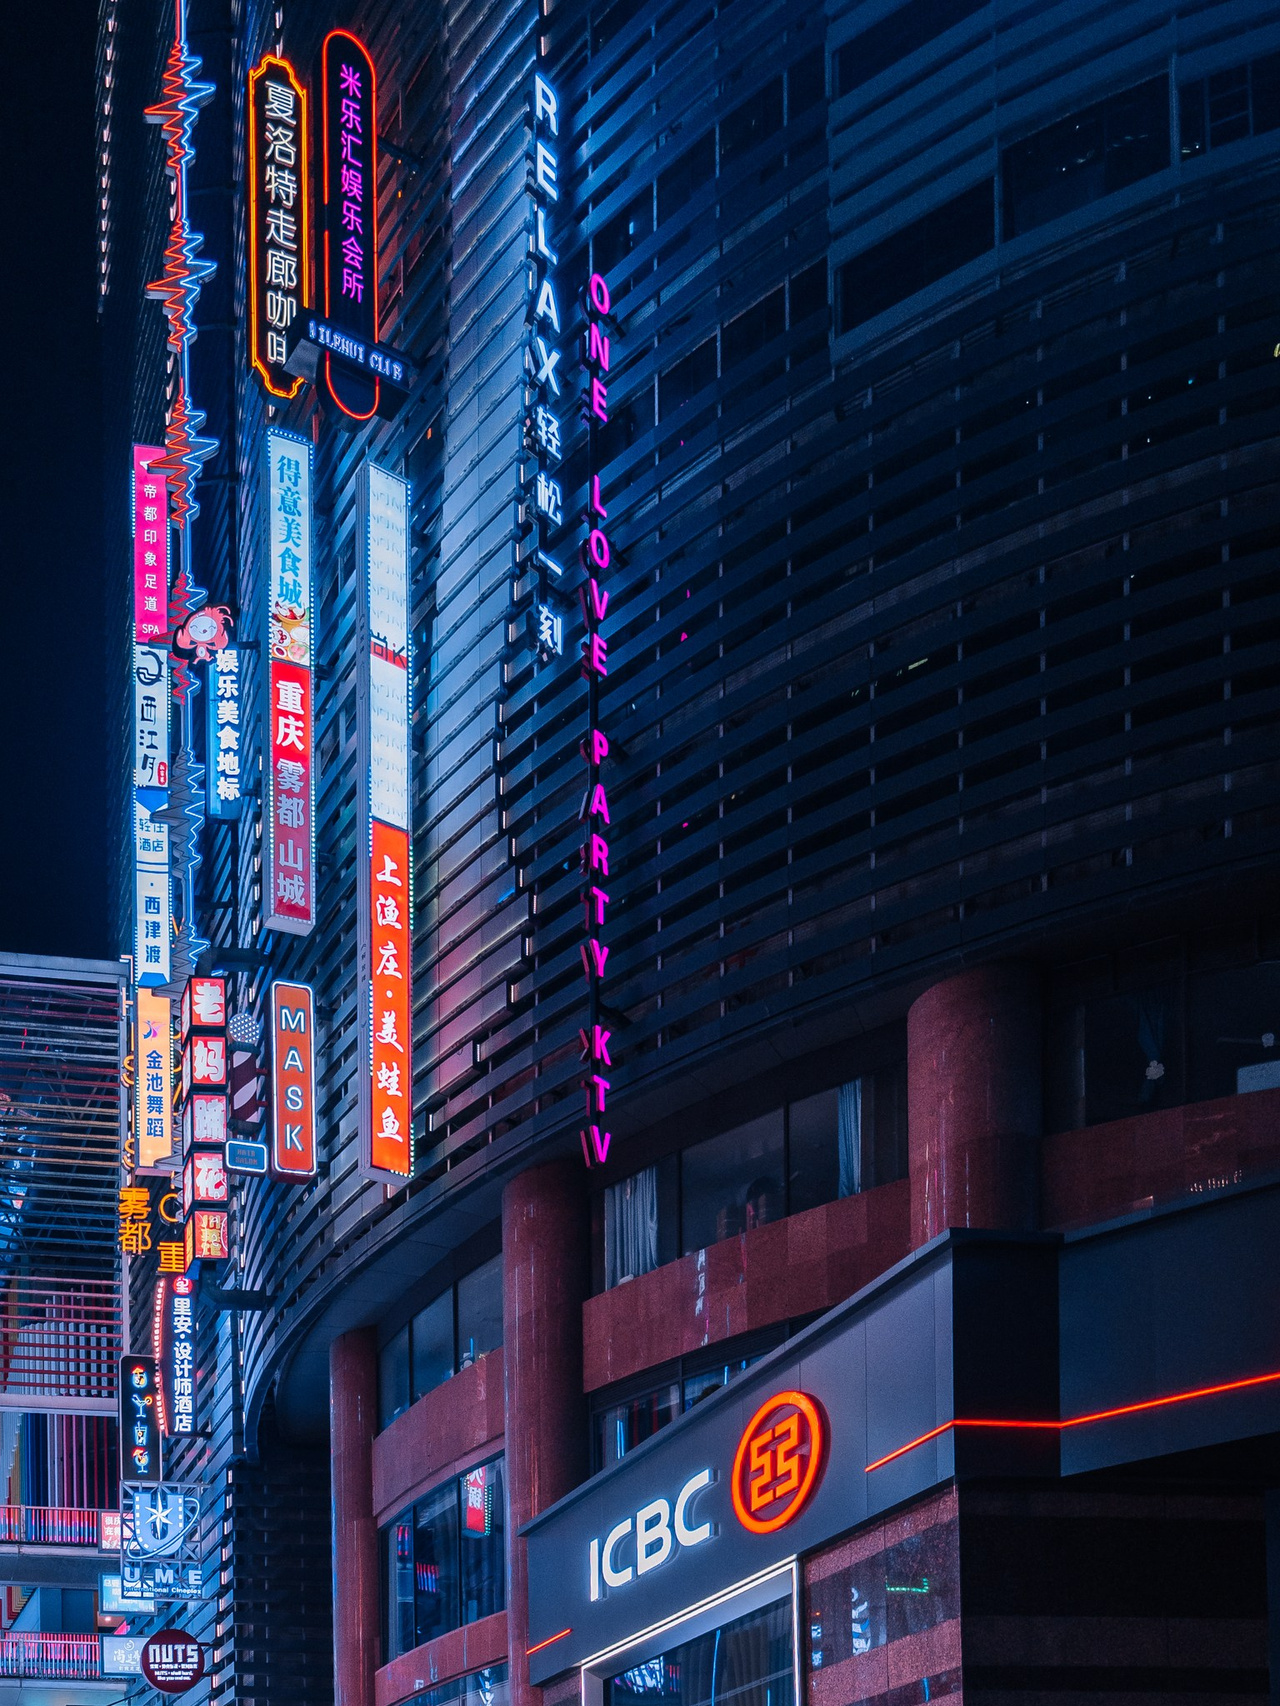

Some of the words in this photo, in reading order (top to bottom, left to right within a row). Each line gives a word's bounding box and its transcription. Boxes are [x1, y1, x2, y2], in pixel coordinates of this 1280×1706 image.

[340, 63, 365, 304] 米乐汇娱乐会所
[143, 483, 158, 612] 帝都印象足道
[276, 455, 303, 609] 得意美食城
[141, 623, 160, 636] SPA
[215, 649, 240, 801] 娱乐美食地标
[138, 837, 164, 852] 酒店
[146, 1049, 164, 1139] 金池舞蹈
[192, 982, 228, 1200] 老妈蹄花
[280, 1007, 305, 1154] MASK
[117, 1187, 152, 1255] 雾都
[123, 1566, 203, 1585] UME
[589, 1468, 716, 1602] ICBC
[171, 1586, 202, 1595] Cineplex
[148, 1644, 199, 1663] NUTS
